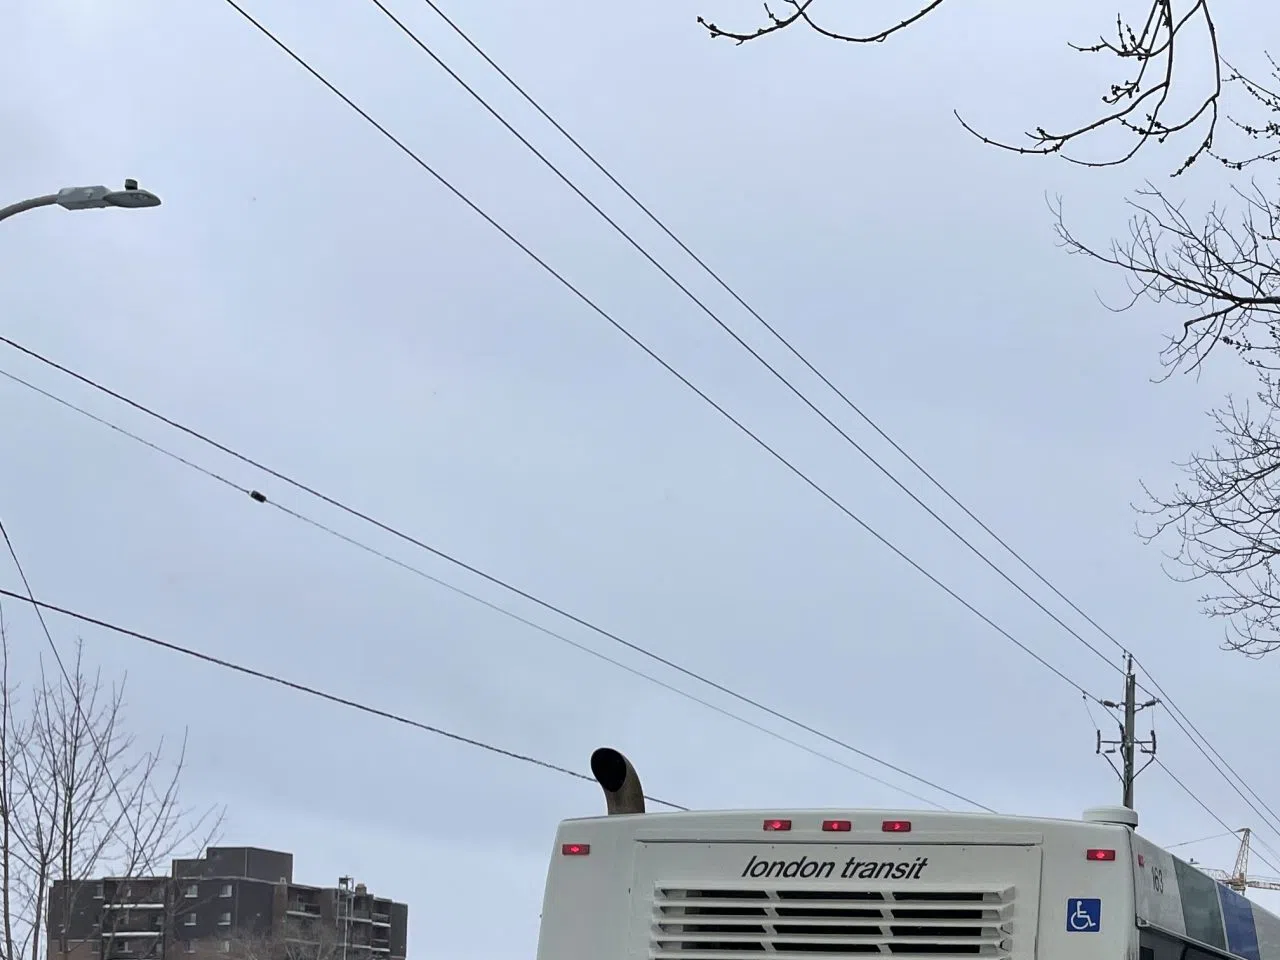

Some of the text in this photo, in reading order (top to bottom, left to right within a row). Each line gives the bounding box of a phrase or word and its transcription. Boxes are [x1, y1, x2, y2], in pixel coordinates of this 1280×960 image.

[741, 856, 928, 879] london transit
[1151, 866, 1164, 894] 163
